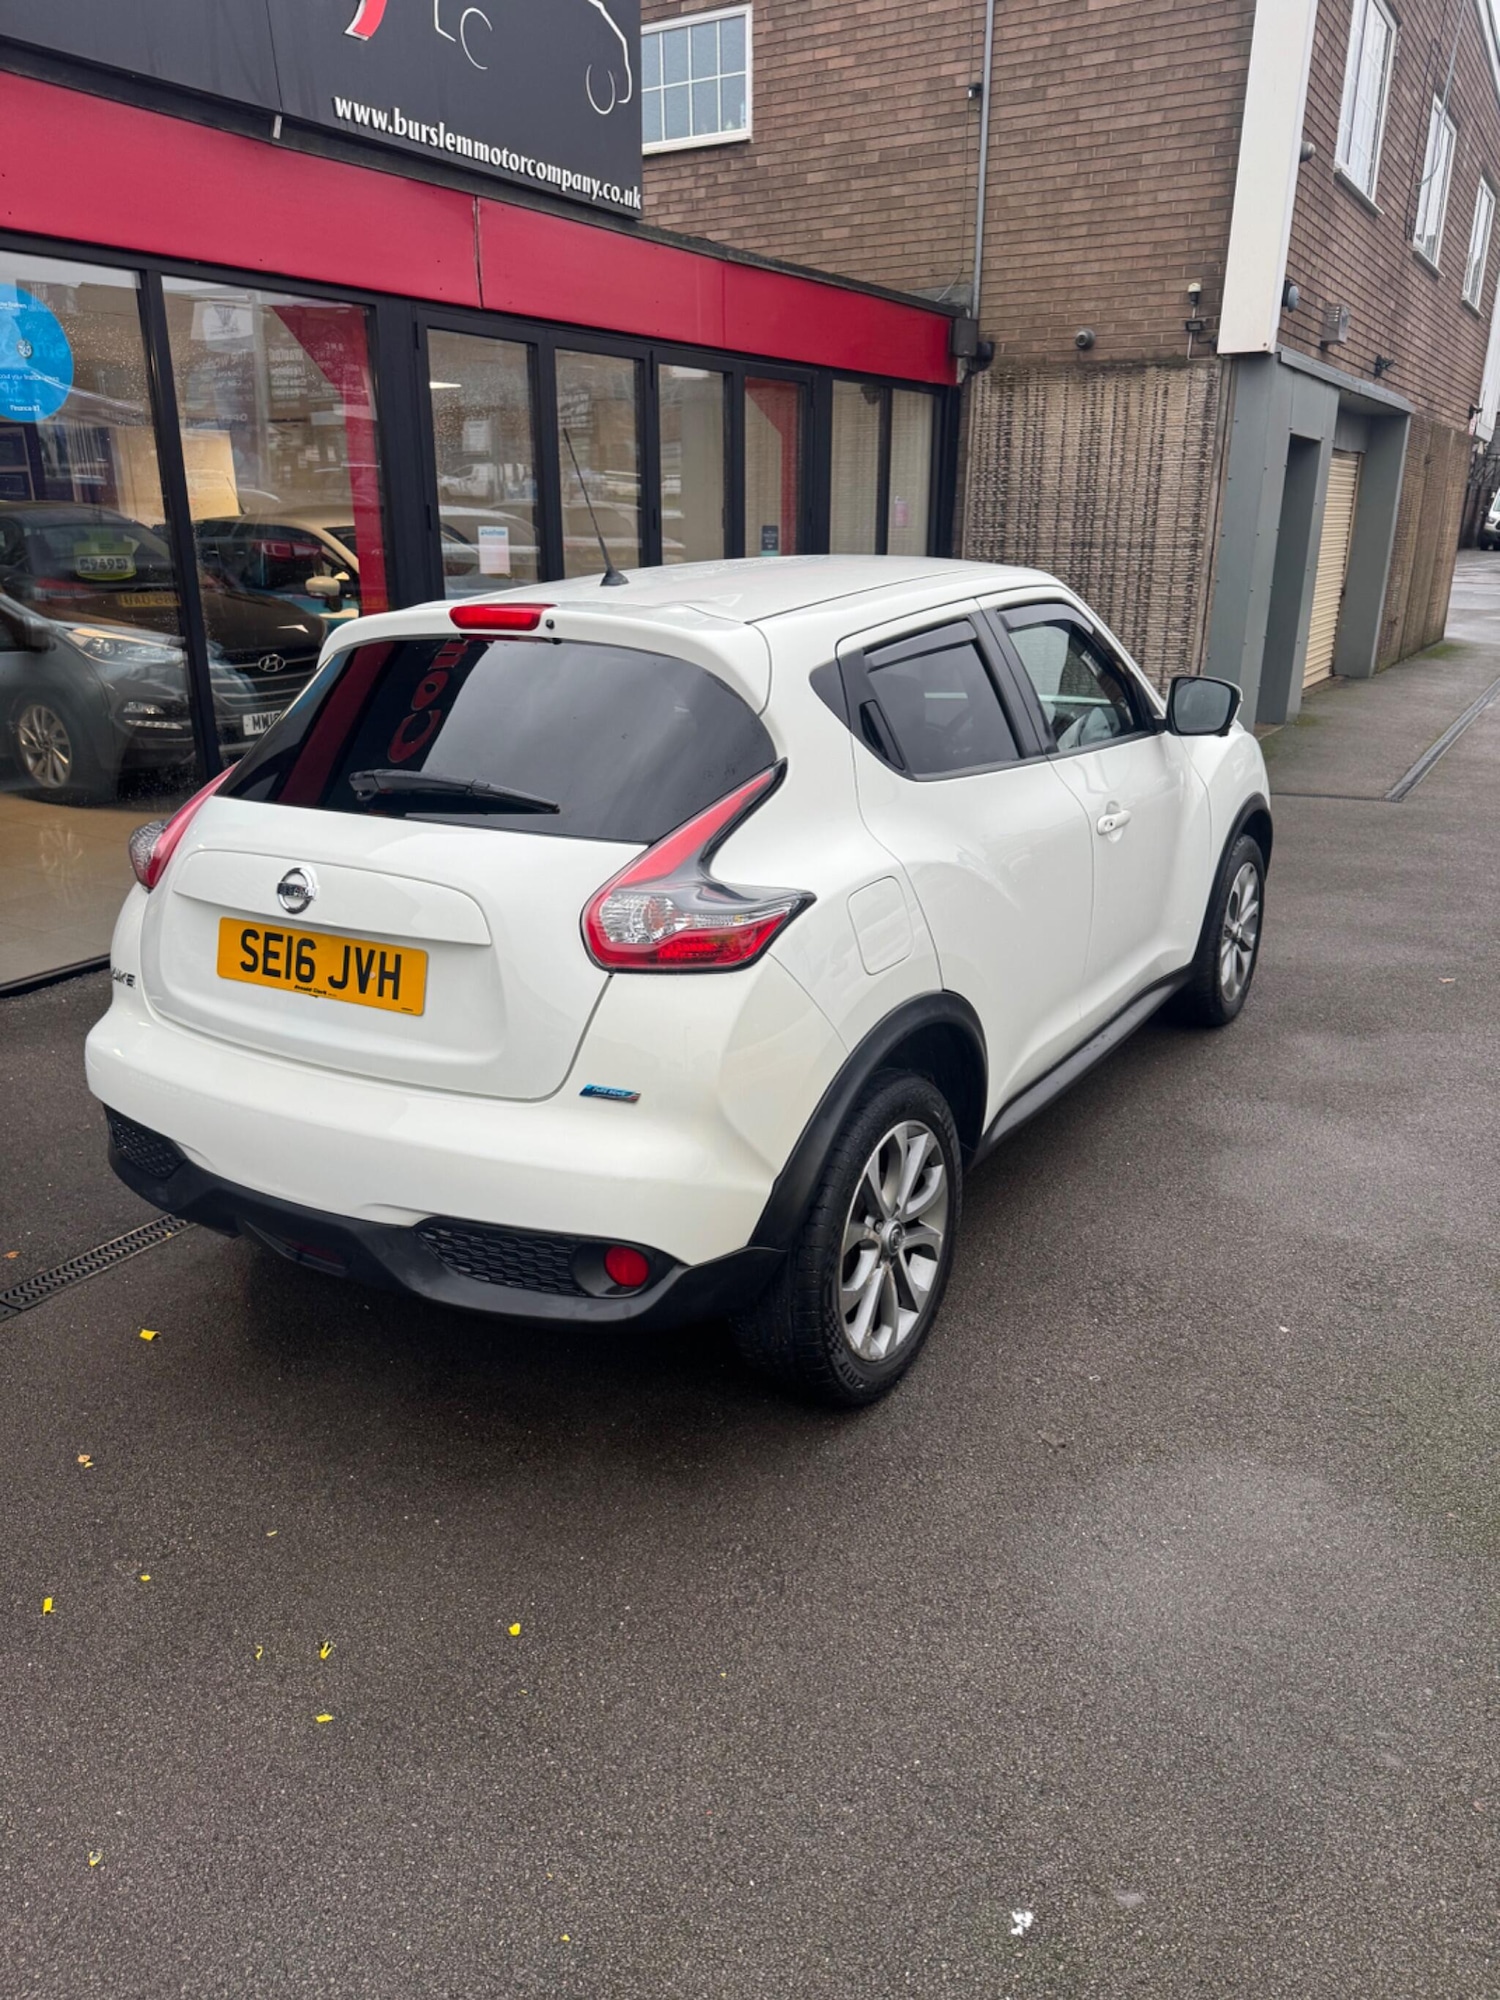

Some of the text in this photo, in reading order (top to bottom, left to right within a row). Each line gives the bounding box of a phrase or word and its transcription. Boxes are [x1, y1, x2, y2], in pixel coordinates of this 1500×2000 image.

[334, 96, 642, 210] www.burslemmotorcompany.co.uk
[240, 929, 402, 1000] SE16 JVH
